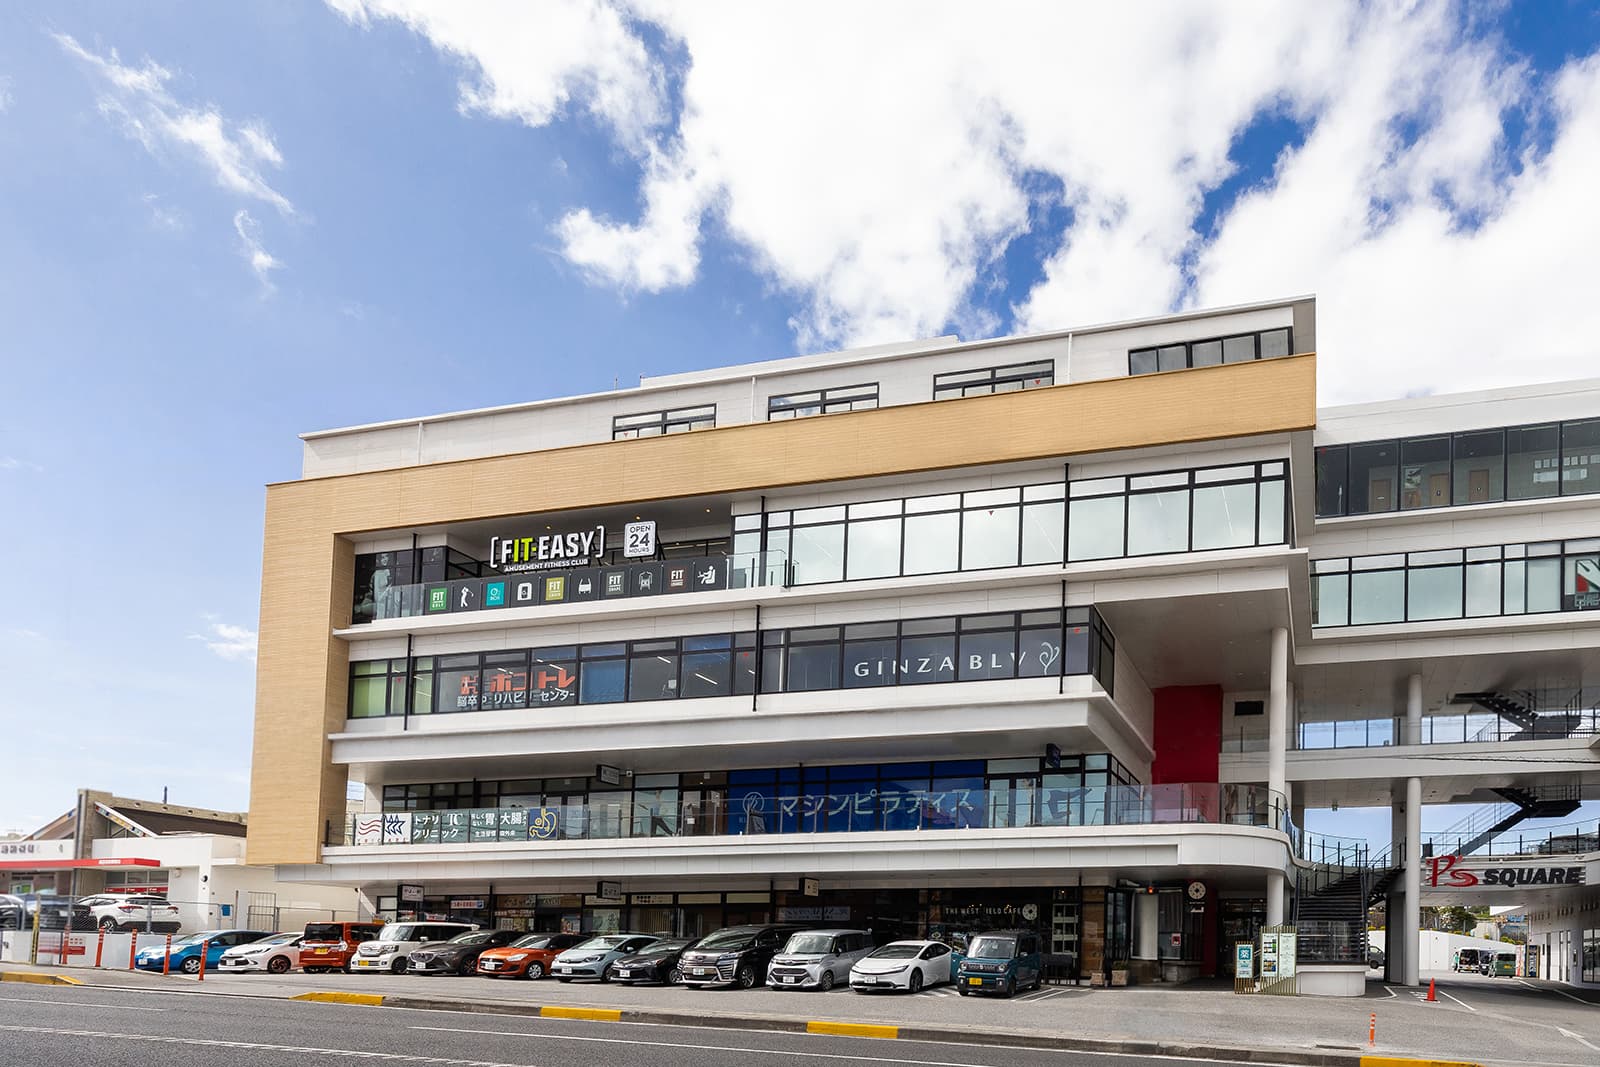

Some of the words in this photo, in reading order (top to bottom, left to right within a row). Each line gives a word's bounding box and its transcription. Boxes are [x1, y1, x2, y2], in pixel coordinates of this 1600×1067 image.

[630, 525, 650, 533] OPEN
[629, 533, 650, 547] 24
[504, 563, 543, 572] AMUSEMENT
[544, 561, 569, 569] FITNESS
[609, 575, 622, 585] FIT
[670, 569, 684, 580] FIT
[549, 581, 561, 591] FIT
[432, 591, 444, 601] FIT
[854, 656, 955, 677] GINZA
[778, 788, 974, 817] マシンピラティス
[415, 815, 439, 825] トナリ
[412, 828, 459, 839] クリニック
[1482, 867, 1581, 887] SQUARE
